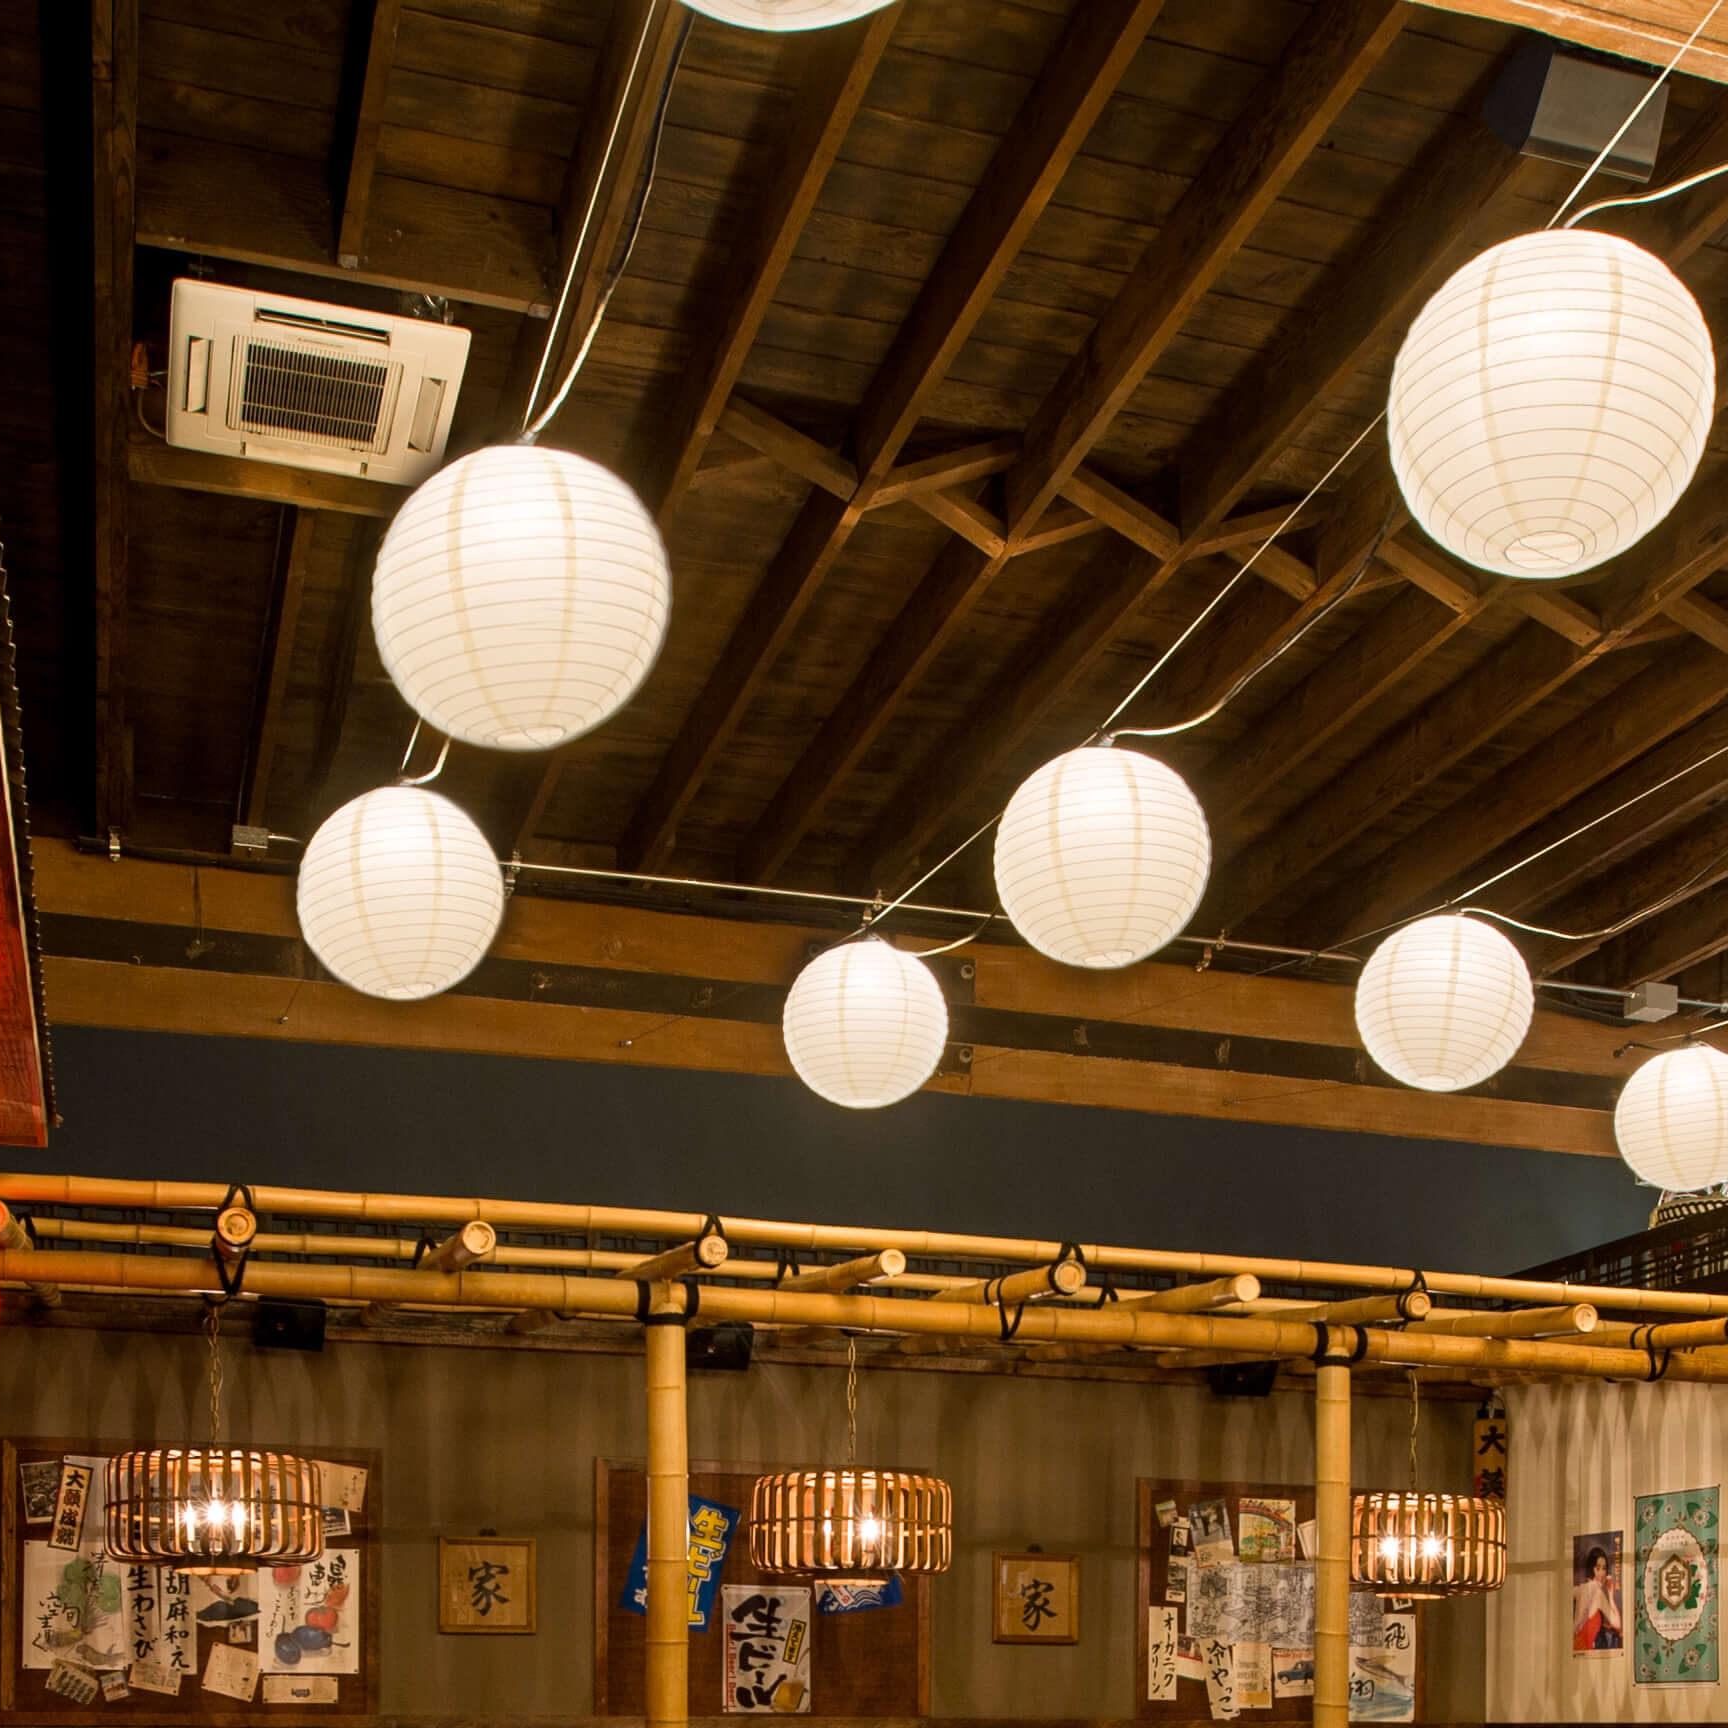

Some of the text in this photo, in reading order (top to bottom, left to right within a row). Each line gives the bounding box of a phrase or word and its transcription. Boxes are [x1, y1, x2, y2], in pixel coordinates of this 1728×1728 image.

[127, 1565, 158, 1660] 生わさび
[165, 1571, 191, 1669] 胡麻和え
[468, 1560, 511, 1616] 家
[1021, 1578, 1058, 1632] 家
[729, 1594, 787, 1709] 生ビール
[1151, 1641, 1162, 1695] グリーン
[1162, 1612, 1176, 1689] オーガニック
[1383, 1621, 1411, 1651] 飛
[1206, 1639, 1235, 1714] 冷やっこ
